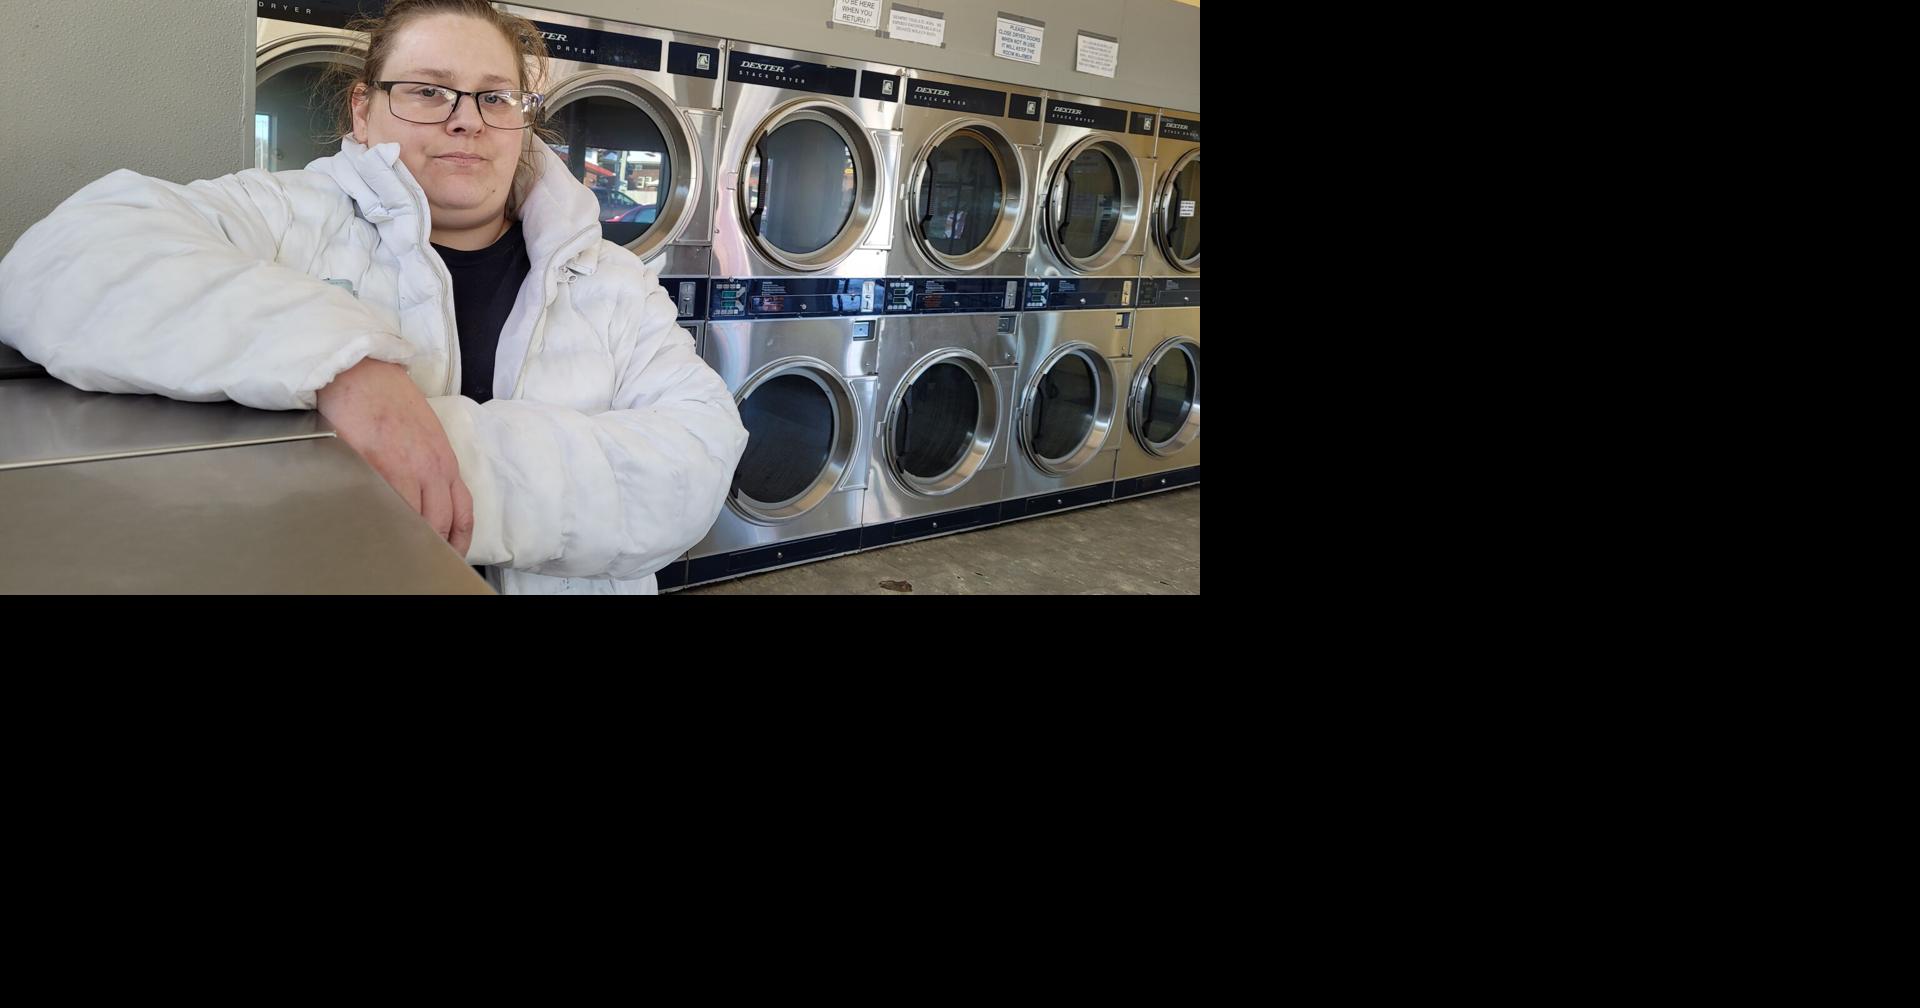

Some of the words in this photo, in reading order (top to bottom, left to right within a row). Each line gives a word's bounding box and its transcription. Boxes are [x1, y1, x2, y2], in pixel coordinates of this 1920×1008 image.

[258, 1, 312, 14] DRYER
[842, 5, 860, 14] WHEN
[860, 8, 873, 17] YOU
[859, 0, 876, 10] HERE
[556, 45, 596, 55] DRYER
[740, 60, 785, 73] DEXTER
[739, 70, 769, 79] STACK
[775, 75, 806, 84] DRYER
[915, 86, 950, 97] DEXTER
[913, 94, 938, 102] STACK
[942, 98, 967, 106] DRYER
[1053, 106, 1082, 115] DEXTER
